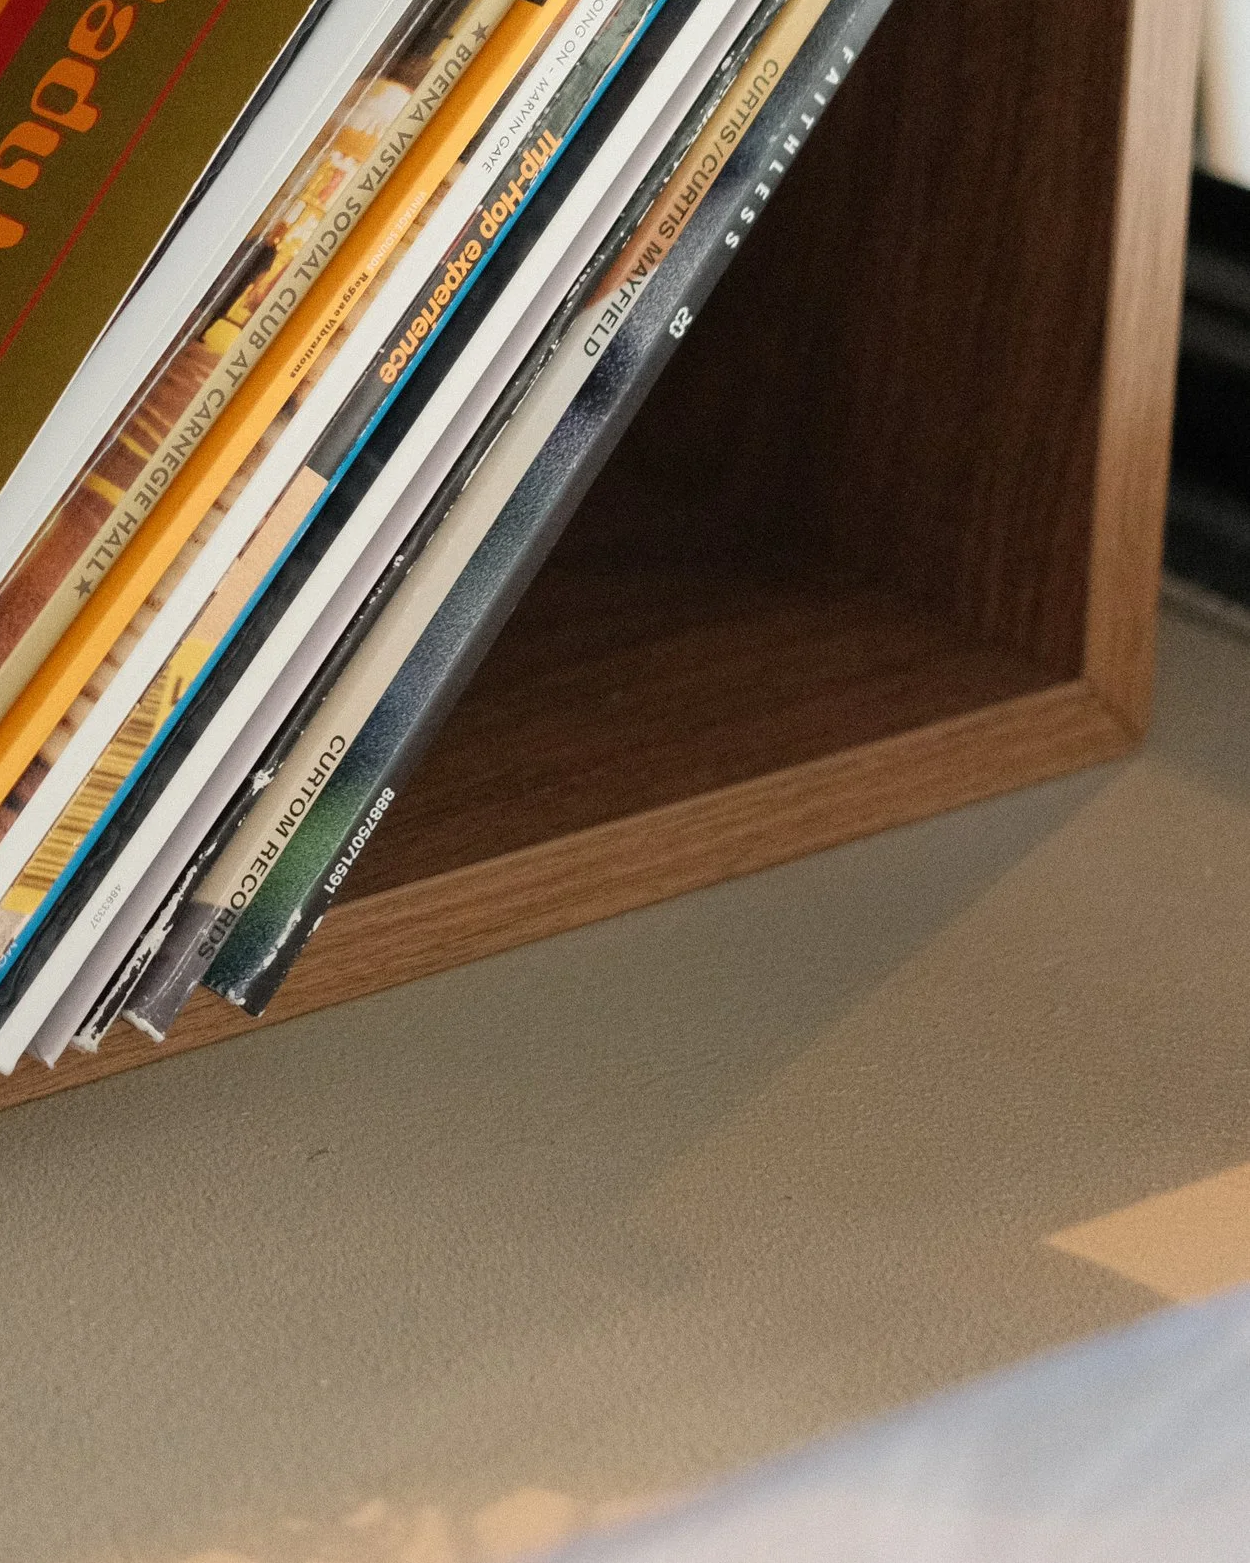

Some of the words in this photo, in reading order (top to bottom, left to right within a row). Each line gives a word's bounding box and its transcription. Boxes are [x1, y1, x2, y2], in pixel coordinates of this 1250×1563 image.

[554, 39, 576, 64] ON
[408, 45, 471, 125] BUENA
[507, 78, 548, 132] MARVIN
[357, 129, 411, 194] VISTA
[480, 135, 510, 172] GAYE
[723, 47, 853, 248] FAITHLESS
[394, 189, 426, 230] VINTAGE
[474, 129, 560, 240] Trip-Hop
[294, 199, 360, 284] SOCIAL
[365, 230, 397, 271] SOUNDS
[247, 287, 298, 349] CLUB
[333, 272, 367, 316] Reggae
[376, 239, 484, 385] experience
[580, 242, 662, 357] MAYFIELD
[668, 306, 697, 341] 20
[220, 350, 252, 386] AT
[289, 318, 335, 378] Vibrations
[133, 387, 225, 508] CARNEGIE
[86, 513, 137, 575] HALL
[275, 734, 346, 836] CURTOM
[324, 787, 394, 893] 88875071591
[197, 841, 278, 960] RECORDS
